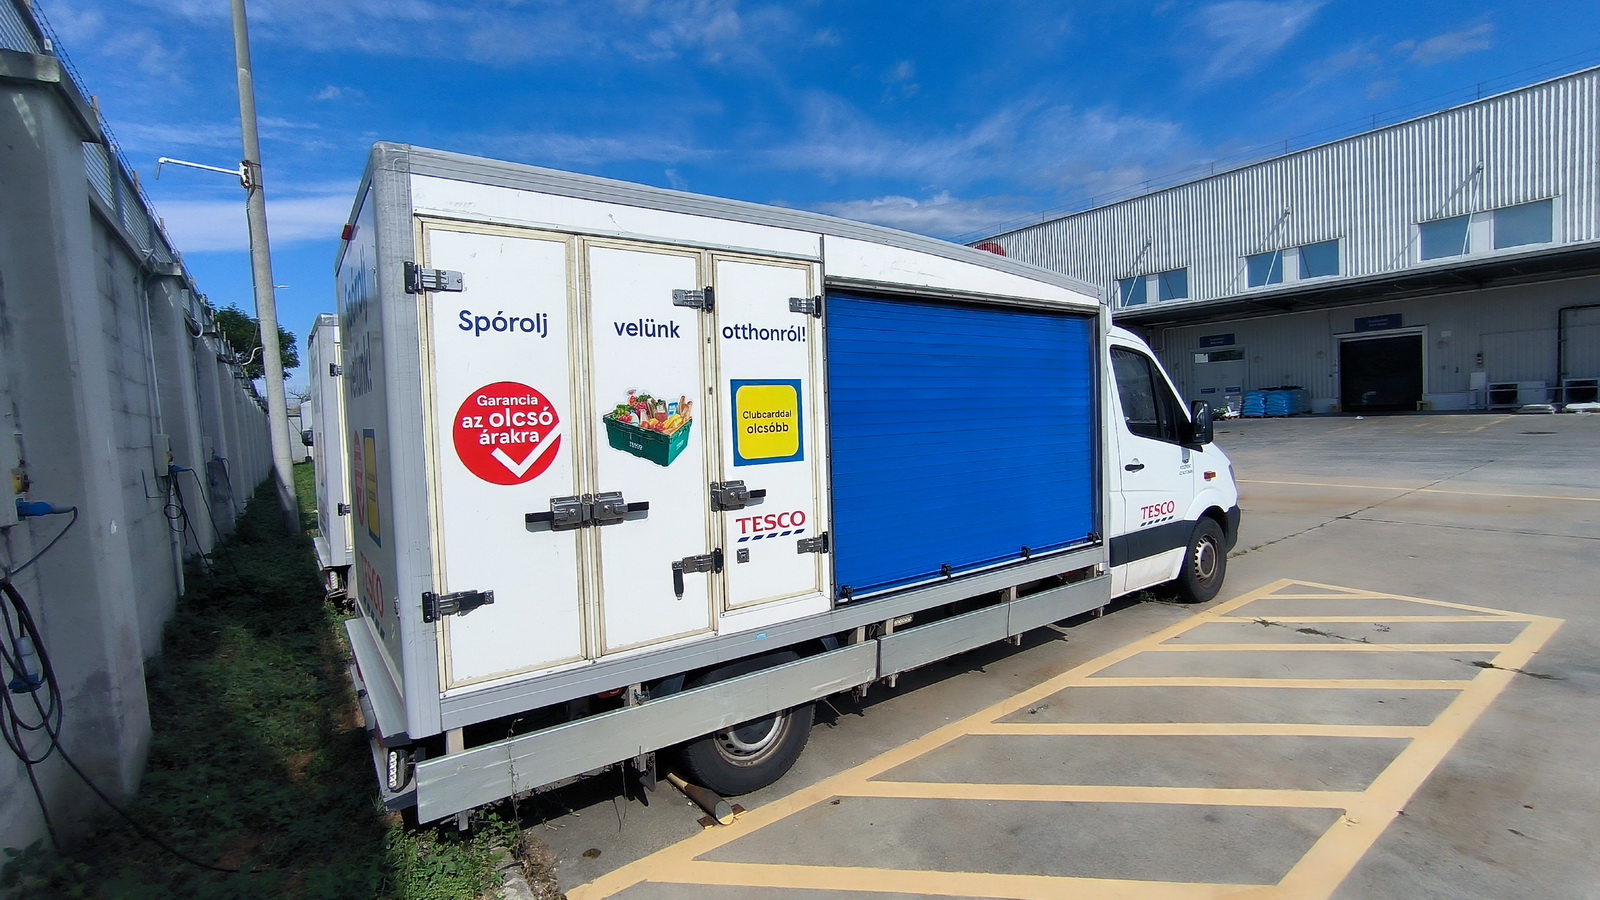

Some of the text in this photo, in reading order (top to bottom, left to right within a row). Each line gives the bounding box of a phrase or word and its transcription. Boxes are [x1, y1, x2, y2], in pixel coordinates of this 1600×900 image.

[459, 309, 806, 342] Spórolj velünk otthonról!
[476, 394, 538, 407] Garancia
[461, 406, 553, 428] az olcsó
[742, 409, 792, 420] Clubcarddal
[479, 429, 540, 445] árakra
[746, 421, 789, 434] olcsóbb
[1141, 500, 1175, 520] TESCO
[736, 510, 805, 534] TESCO
[360, 550, 384, 619] TESCO
